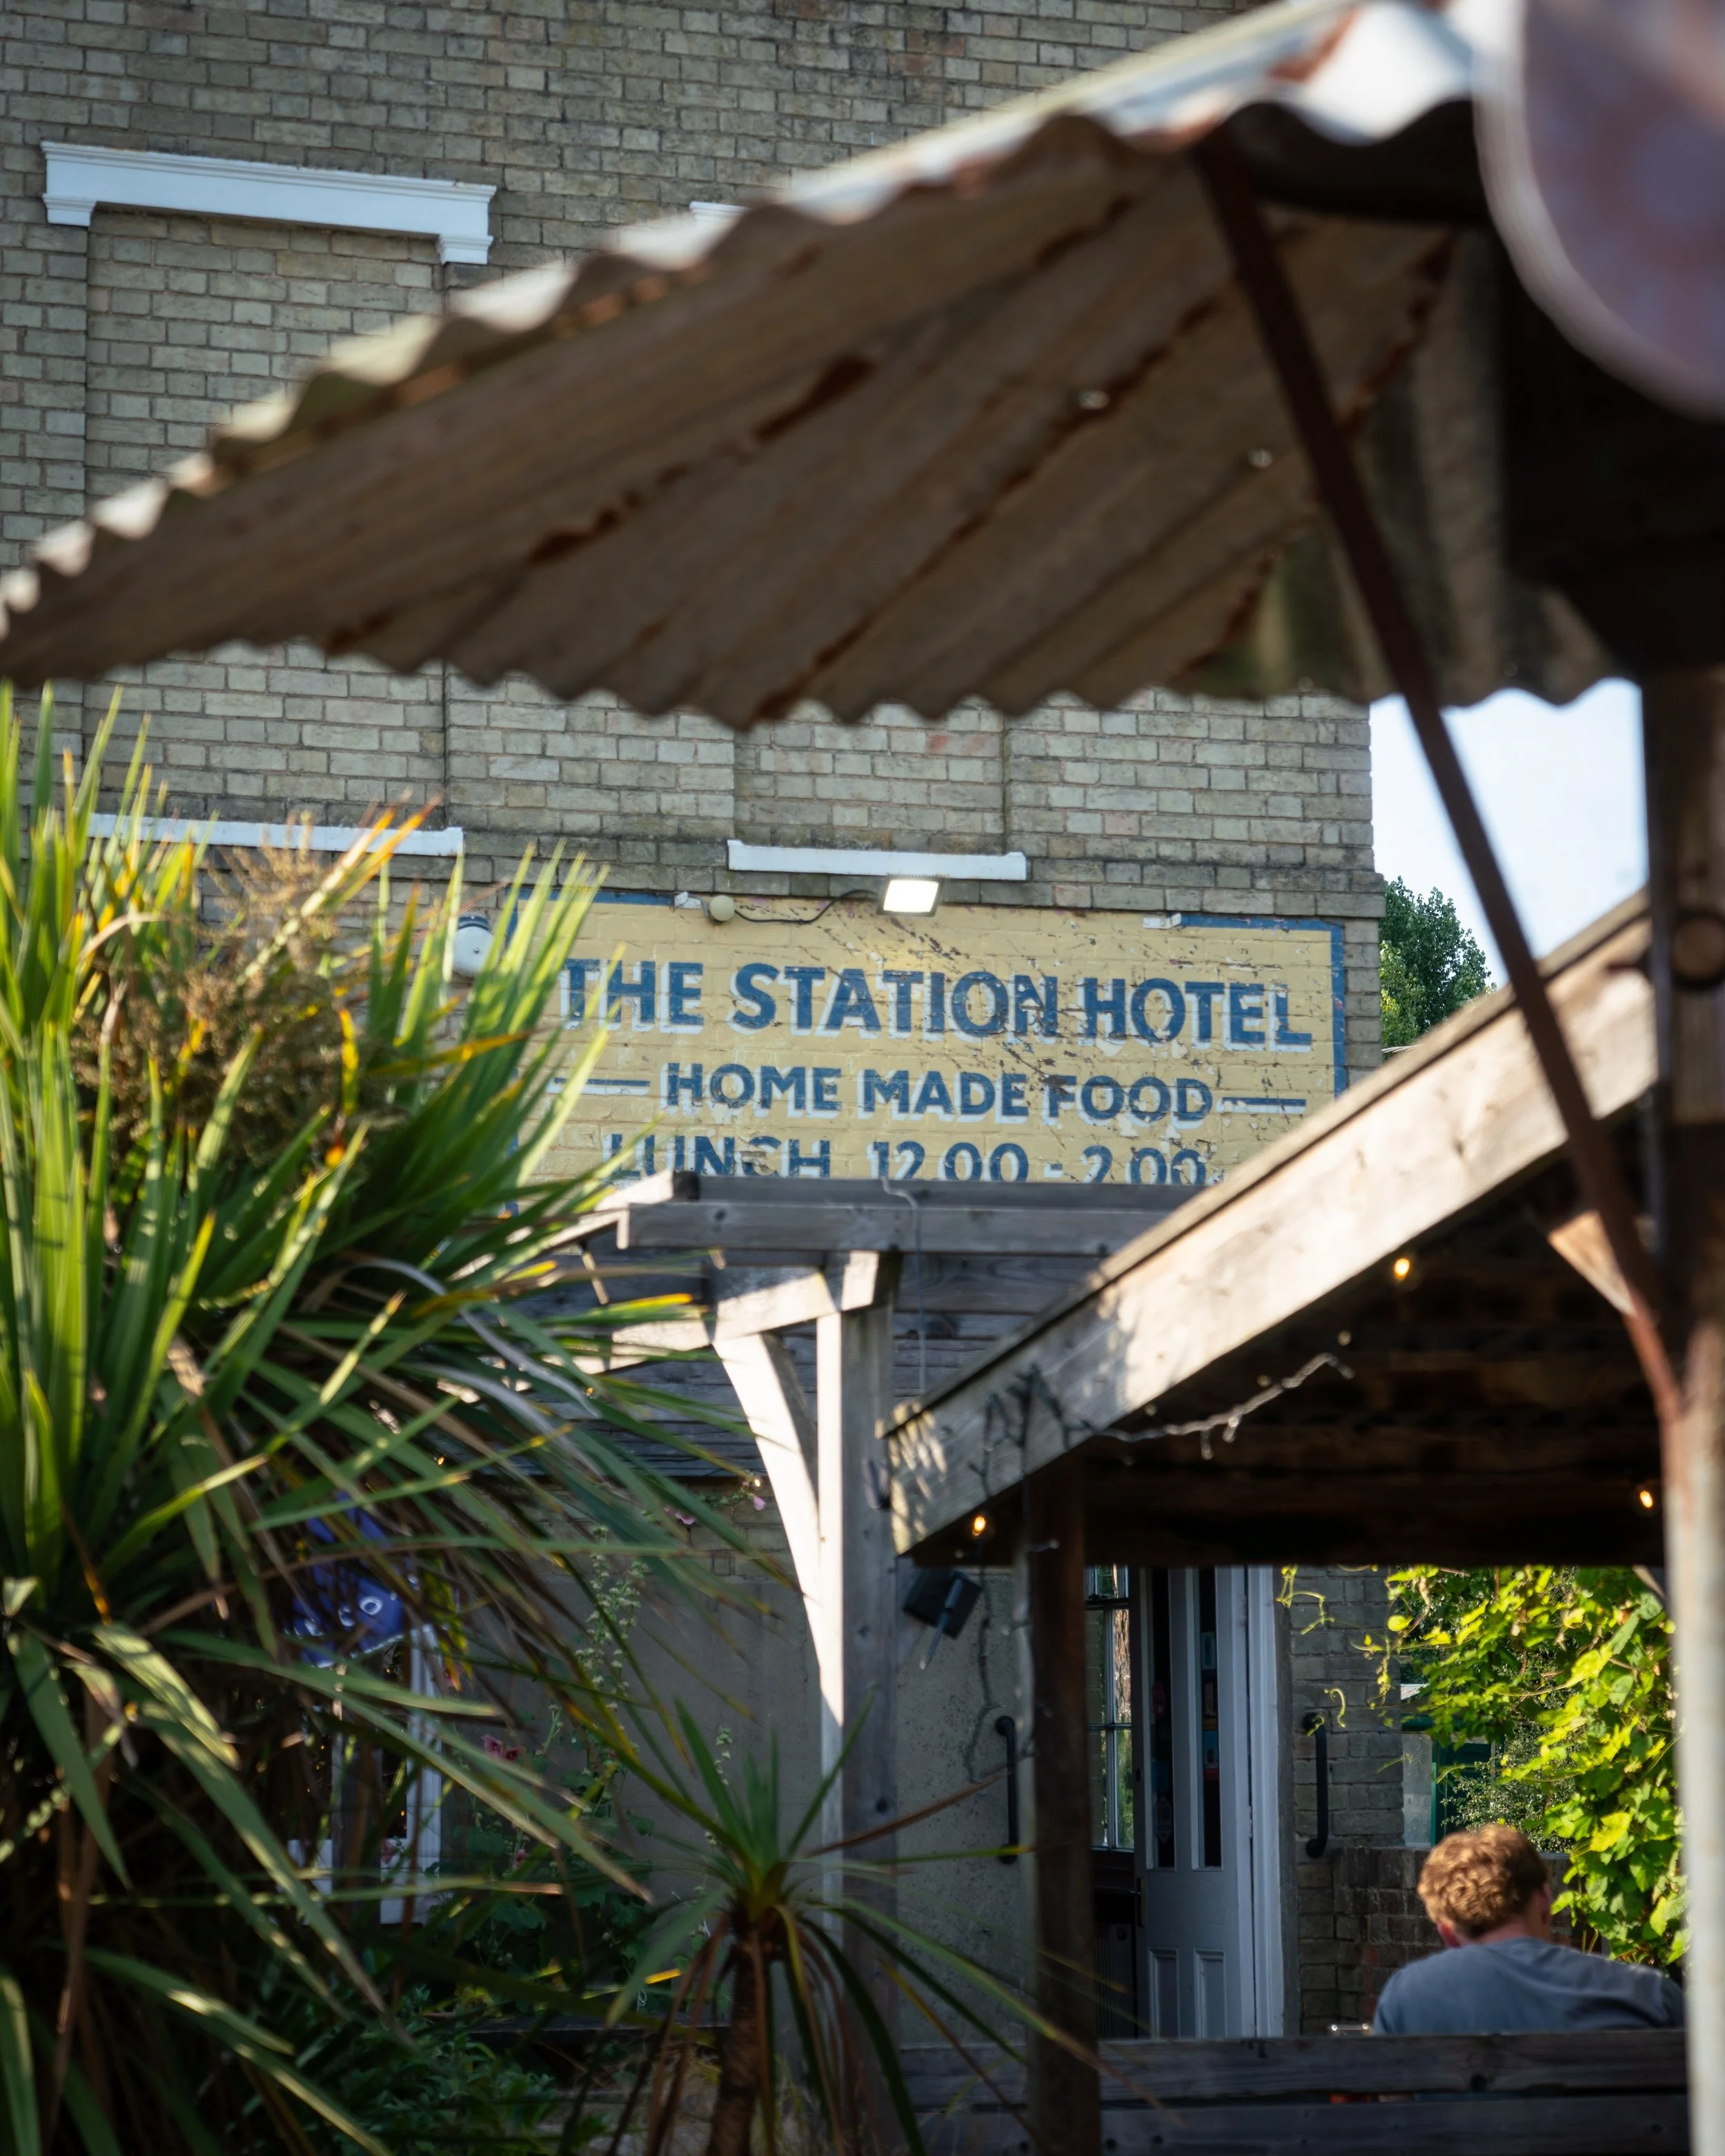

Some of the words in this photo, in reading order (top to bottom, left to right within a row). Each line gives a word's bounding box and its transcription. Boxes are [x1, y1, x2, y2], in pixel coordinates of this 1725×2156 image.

[560, 958, 704, 1034] THE
[727, 962, 1058, 1043] STATION
[1078, 978, 1312, 1053] HOTEL
[660, 1062, 843, 1118] HOME
[857, 1069, 1029, 1125] MADE
[1043, 1074, 1214, 1130] FOOD
[602, 1134, 831, 1179] LUNCH
